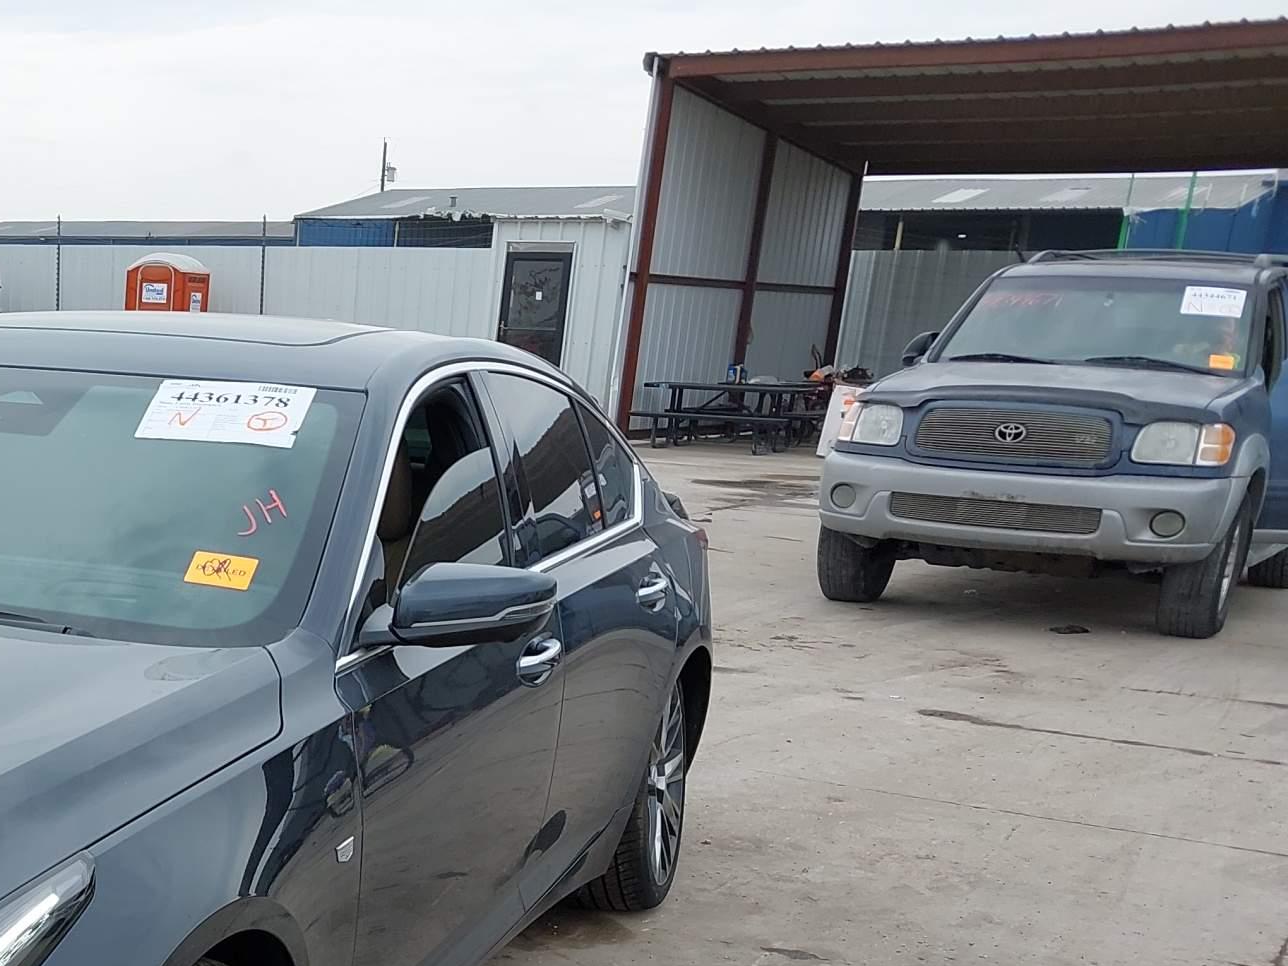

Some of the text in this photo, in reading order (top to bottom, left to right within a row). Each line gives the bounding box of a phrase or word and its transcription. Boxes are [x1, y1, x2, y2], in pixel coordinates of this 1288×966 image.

[170, 391, 291, 408] 44361378
[168, 407, 202, 426] N
[237, 489, 287, 536] JH
